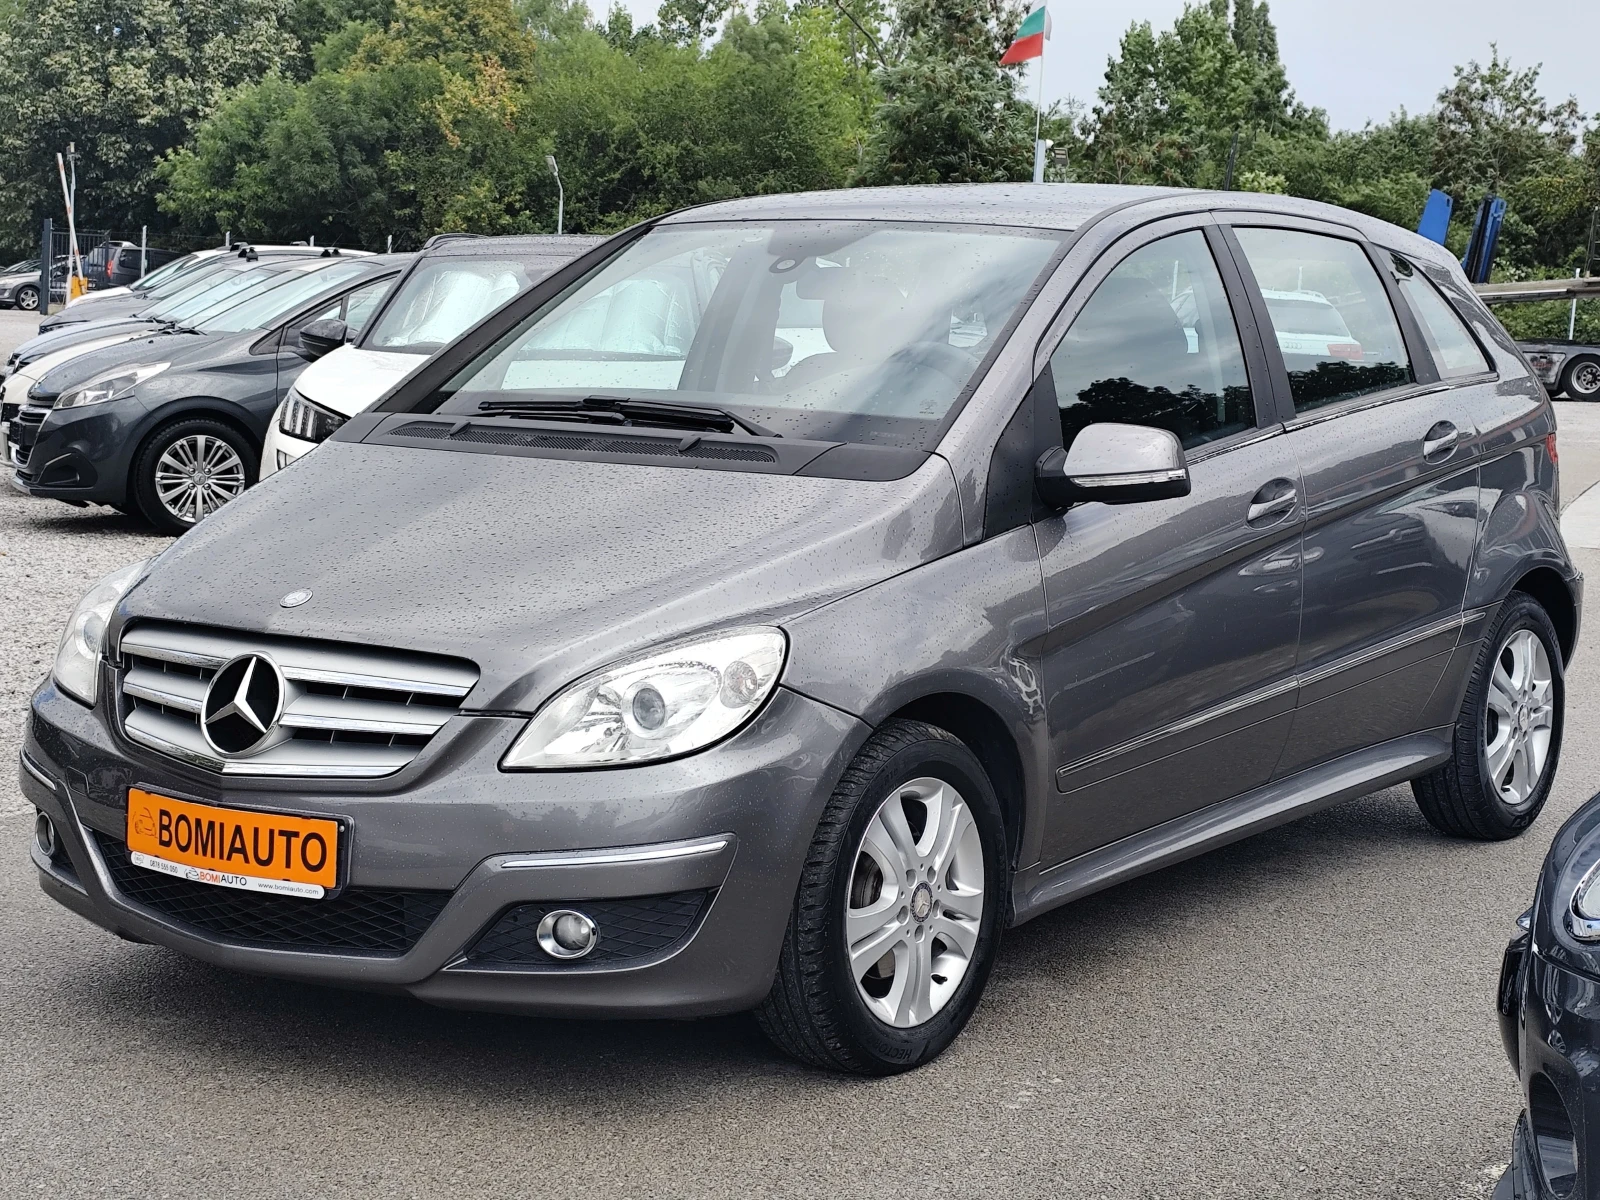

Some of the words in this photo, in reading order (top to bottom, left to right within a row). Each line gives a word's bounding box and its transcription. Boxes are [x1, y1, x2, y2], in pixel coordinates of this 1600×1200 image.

[158, 809, 327, 872] BOMIAUTO
[199, 871, 247, 887] BOMIAUTO
[257, 882, 319, 896] www.bomiauto.com
